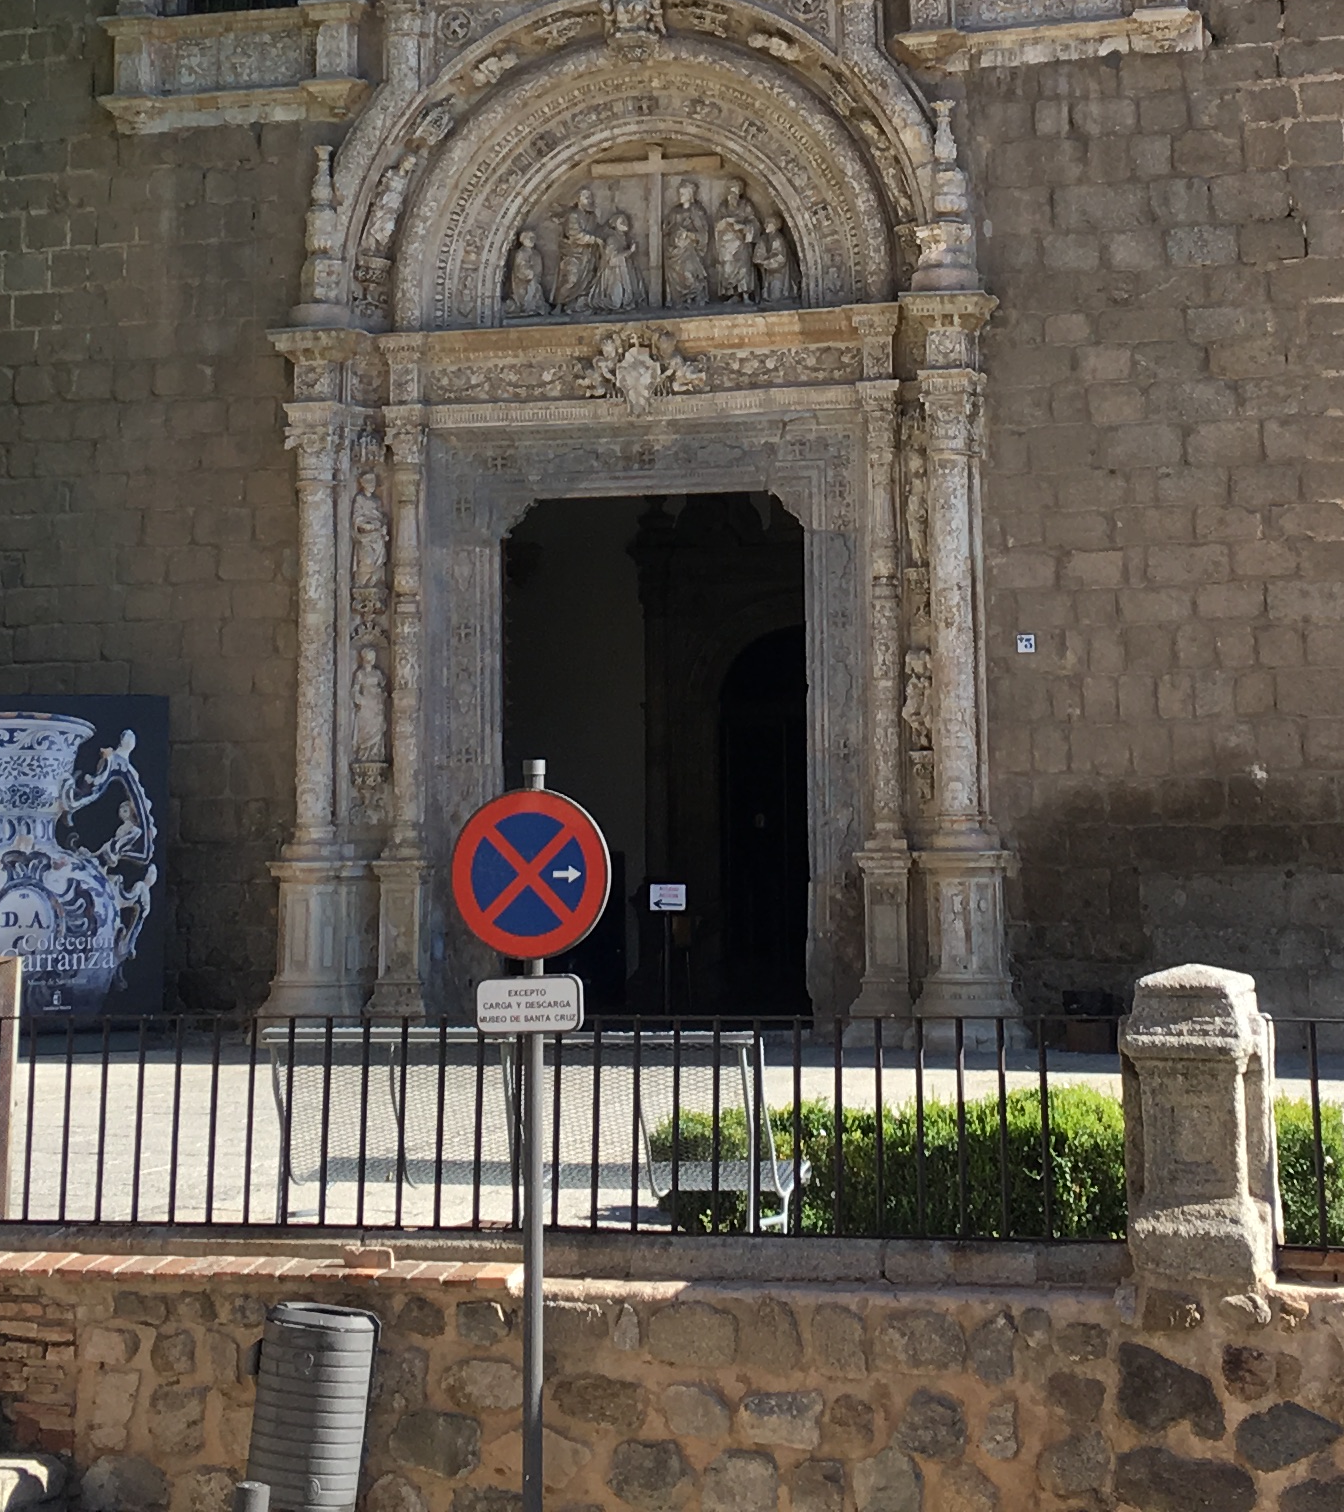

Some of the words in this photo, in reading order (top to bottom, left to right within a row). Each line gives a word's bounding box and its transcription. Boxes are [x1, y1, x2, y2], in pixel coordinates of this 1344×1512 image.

[0, 911, 23, 929] D.
[25, 910, 51, 929] A.
[22, 931, 115, 951] Colección
[508, 988, 547, 997] EXCEPTO
[483, 1001, 513, 1010] CARGA
[516, 1001, 522, 1009] Y
[525, 1000, 571, 1009] DESCARGA
[479, 1015, 507, 1023] MUSEO
[510, 1015, 521, 1023] DE
[524, 1014, 551, 1023] SANTA
[554, 1013, 577, 1022] CRUZ
